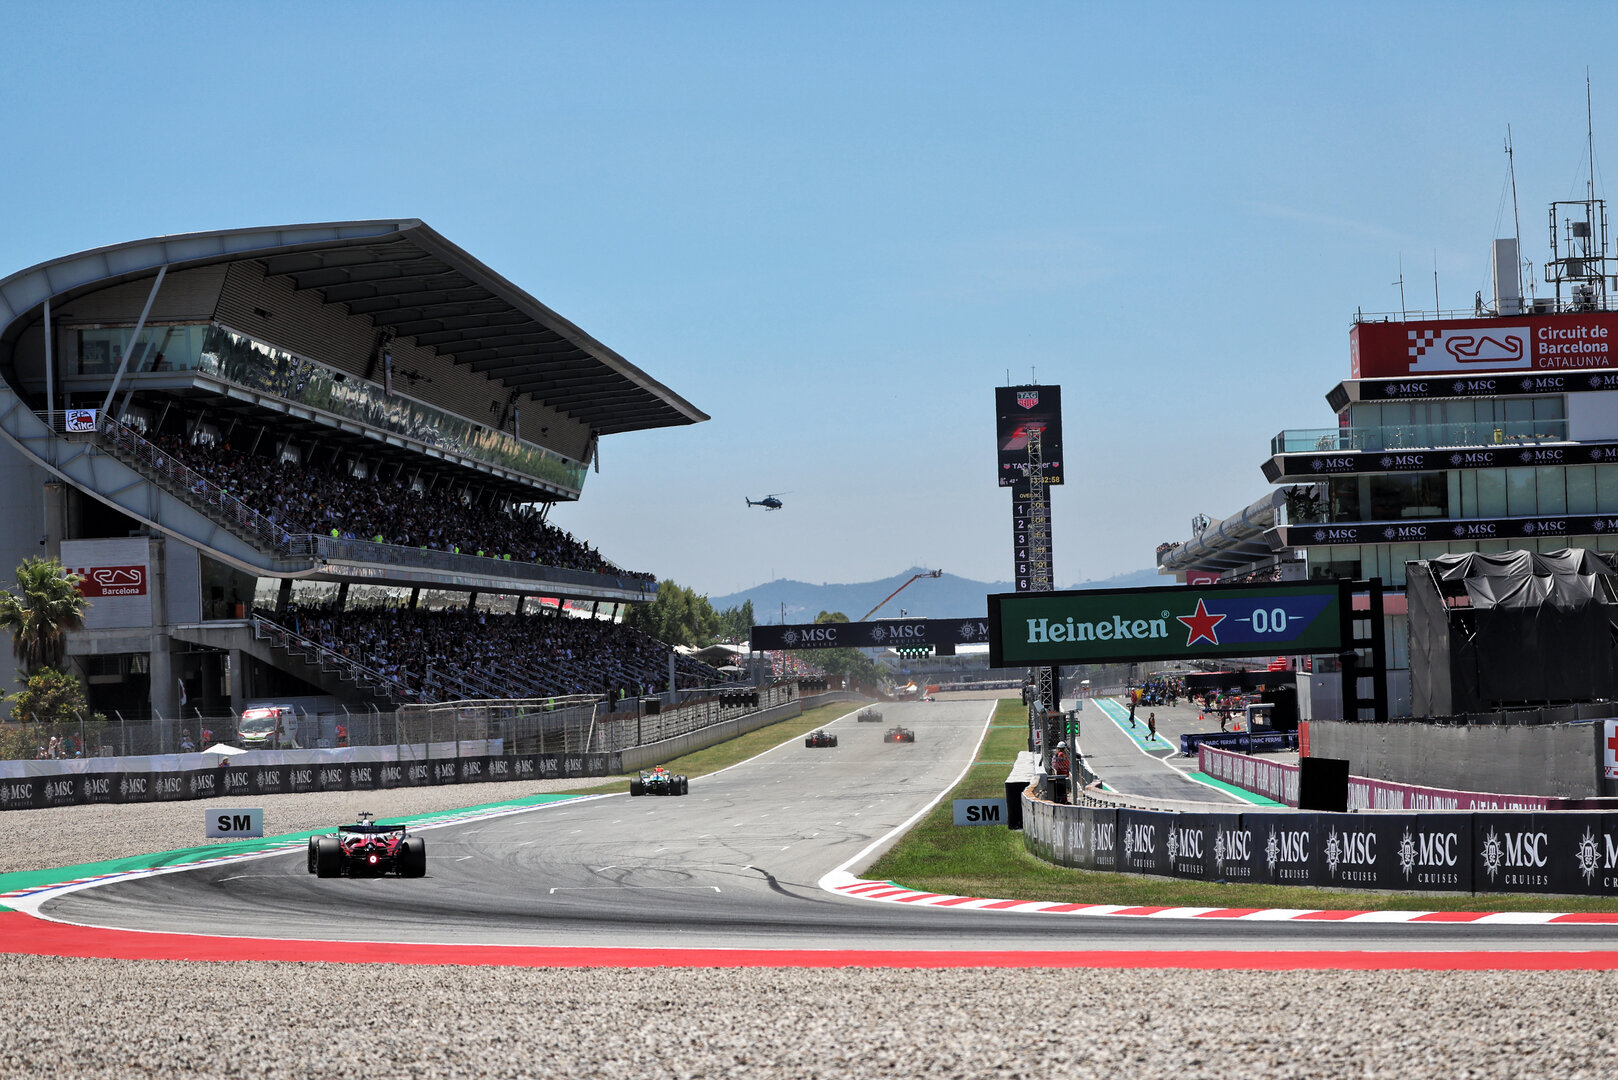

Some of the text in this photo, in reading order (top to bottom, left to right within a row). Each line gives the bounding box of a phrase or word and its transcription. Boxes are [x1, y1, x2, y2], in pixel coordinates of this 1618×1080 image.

[1538, 325, 1608, 340] Circuit de
[1539, 341, 1609, 354] Barcelona
[1539, 356, 1610, 368] CATALUNYA
[1400, 383, 1428, 393] MSC
[1468, 380, 1496, 390] MSC
[1536, 377, 1564, 387] MSC
[1395, 455, 1424, 465] MSC
[1465, 453, 1493, 462] MSC
[1535, 450, 1563, 460] MSC
[1326, 458, 1354, 468] MSC
[1018, 505, 1023, 513] 1
[1018, 520, 1024, 528] 2
[1468, 524, 1496, 534] MSC
[1537, 521, 1566, 531] MSC
[1329, 529, 1357, 539] MSC
[1398, 526, 1426, 536] MSC
[1019, 535, 1025, 543] 3
[1019, 550, 1025, 558] 4
[1020, 565, 1026, 573] 5
[102, 586, 139, 595] Barcelona
[1021, 580, 1027, 588] 6
[801, 628, 837, 641] MSC
[889, 624, 925, 638] MSC
[296, 770, 312, 783] MSC
[327, 769, 342, 782] MSC
[357, 768, 372, 781] MSC
[386, 767, 401, 780] MSC
[441, 763, 455, 777] MSC
[197, 774, 215, 789] MSC
[231, 772, 249, 786] MSC
[264, 770, 280, 784] MSC
[11, 784, 32, 799] MSC
[54, 781, 73, 796] MSC
[92, 779, 110, 793] MSC
[129, 779, 147, 793] MSC
[164, 778, 181, 792] MSC
[966, 805, 1000, 821] SM
[217, 815, 251, 831] SM
[1097, 823, 1115, 851] MSC
[1134, 825, 1155, 853] MSC
[1178, 829, 1203, 859] MSC
[1226, 831, 1251, 861] MSC
[1279, 831, 1310, 862] MSC
[1342, 832, 1377, 865] MSC
[1418, 832, 1458, 866] MSC
[1504, 832, 1548, 868] MSC
[1179, 864, 1203, 874] CRUISES
[1225, 867, 1251, 877] CRUISES
[1279, 868, 1309, 879] CRUISES
[1342, 871, 1377, 881] CRUISES
[1418, 873, 1458, 884] CRUISES
